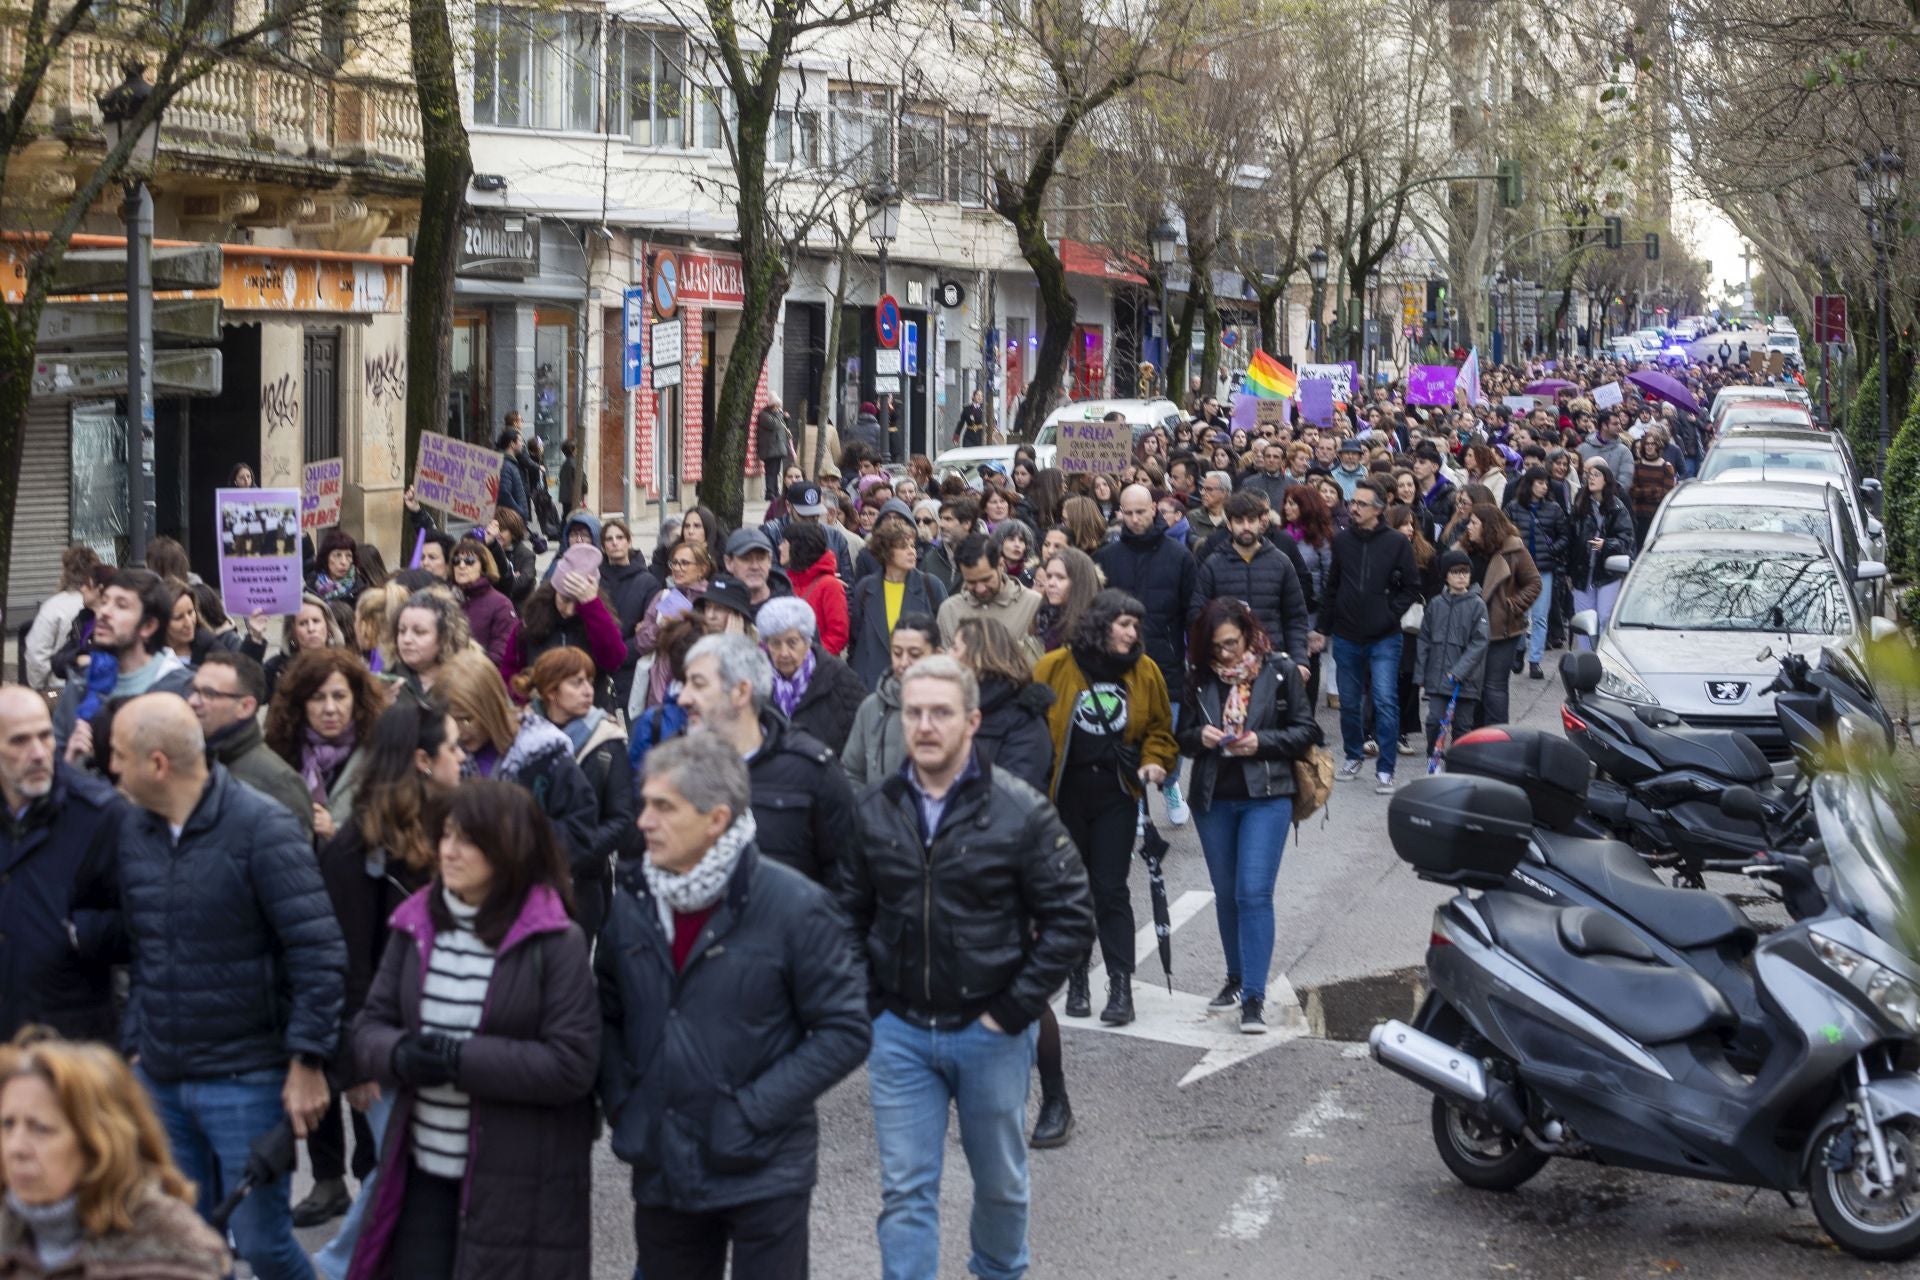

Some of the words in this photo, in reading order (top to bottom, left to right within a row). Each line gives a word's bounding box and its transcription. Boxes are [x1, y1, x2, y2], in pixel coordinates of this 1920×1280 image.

[1078, 424, 1114, 440] ABUELA
[305, 462, 340, 481] QUIERO
[1062, 457, 1088, 471] PARA
[1092, 459, 1113, 473] ELLA
